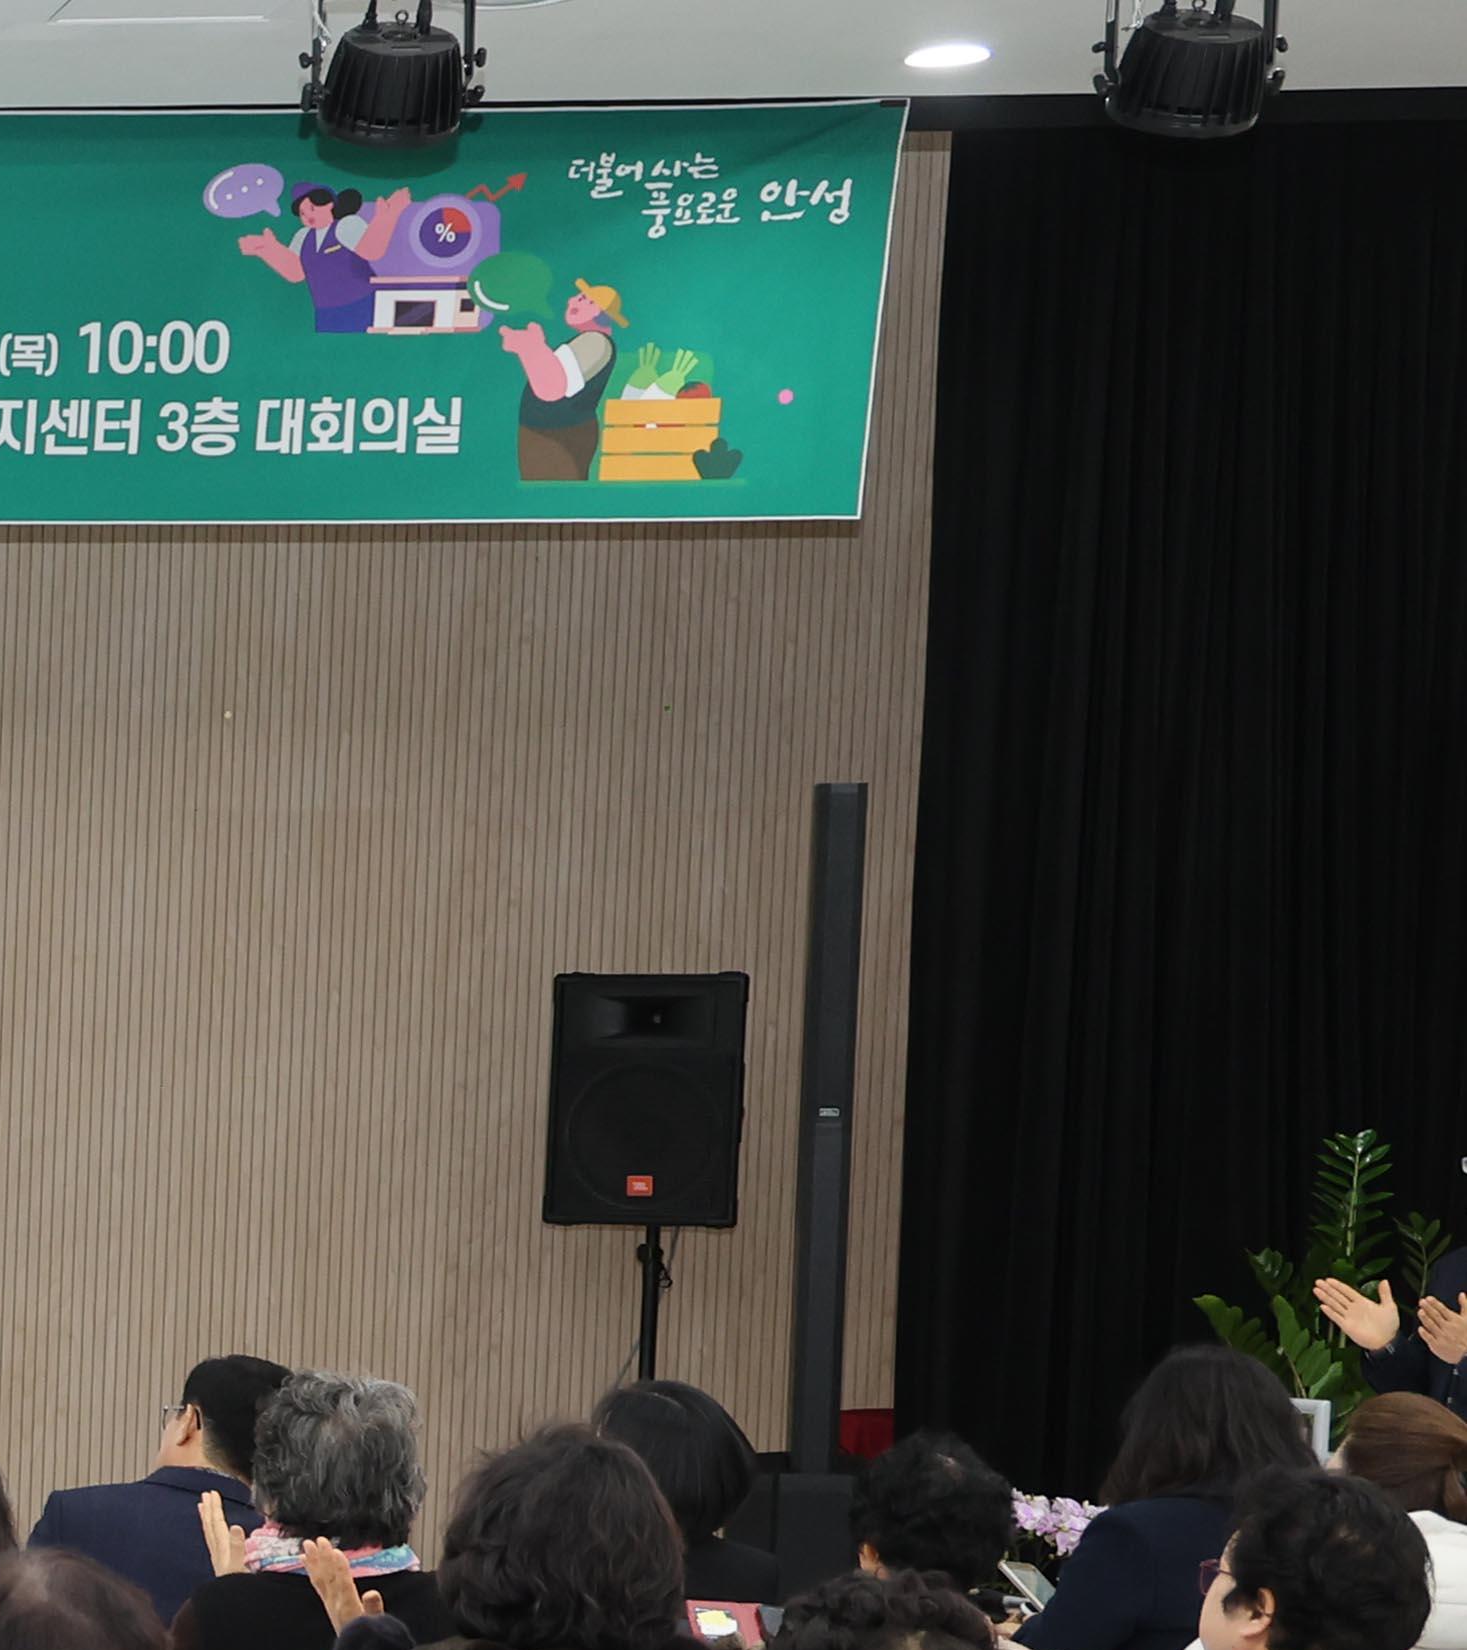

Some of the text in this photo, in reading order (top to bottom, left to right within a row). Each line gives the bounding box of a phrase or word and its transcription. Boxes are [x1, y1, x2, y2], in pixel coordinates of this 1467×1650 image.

[568, 152, 719, 199] 더불어 사는
[641, 178, 853, 239] 풍요로운 안성
[78, 320, 231, 376] 10:00
[155, 396, 241, 457] 3층
[254, 396, 463, 456] 대회의실
